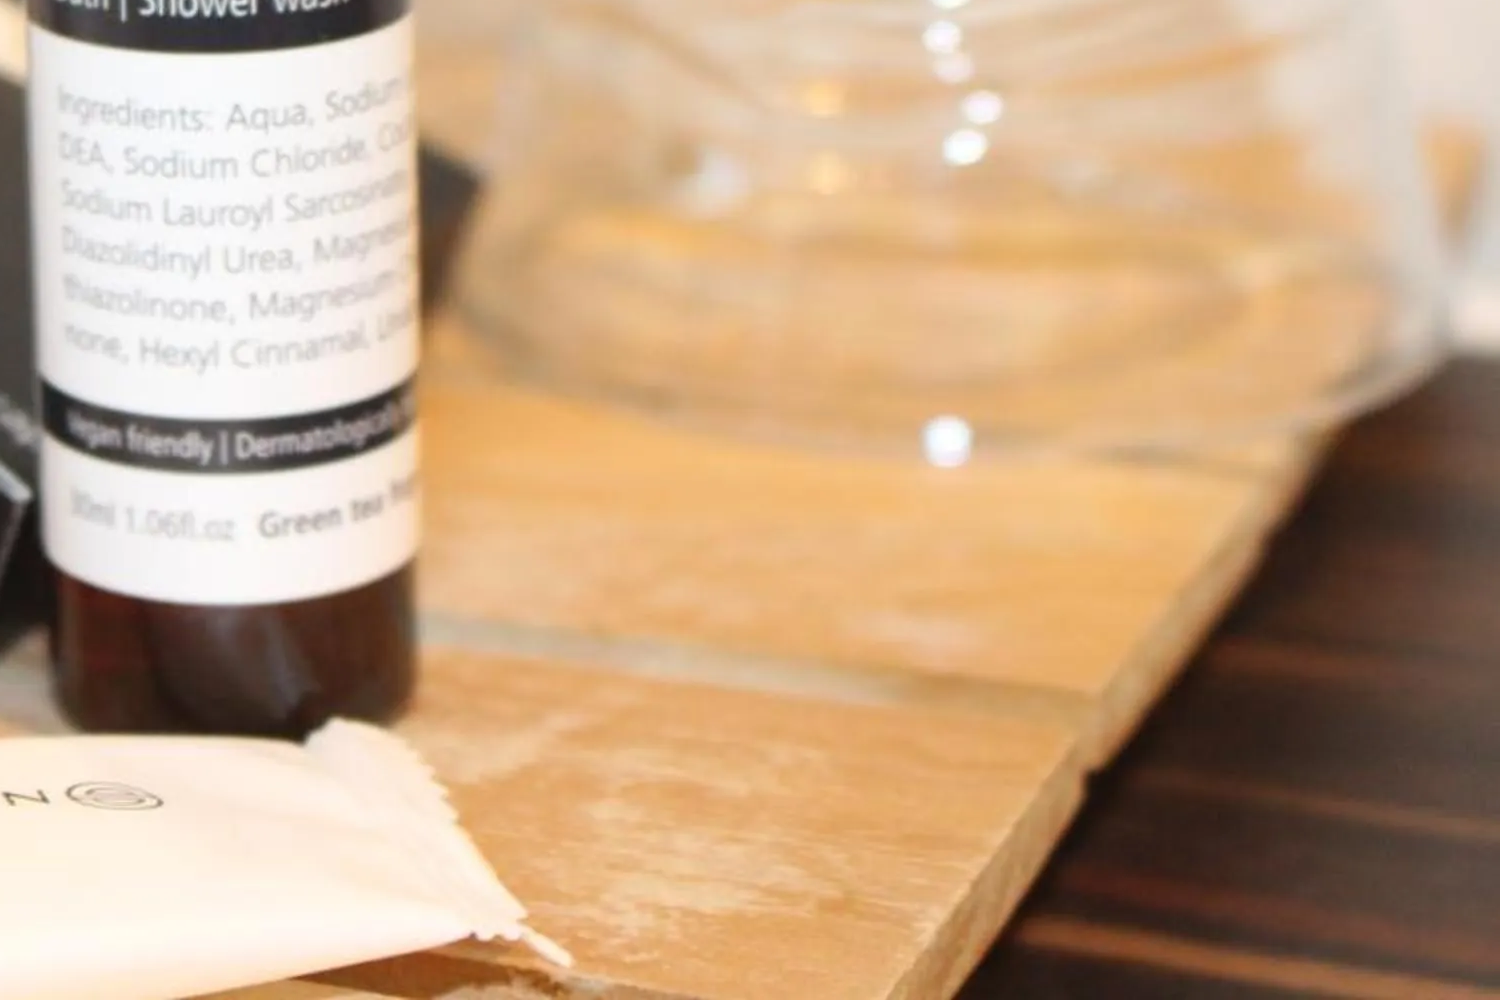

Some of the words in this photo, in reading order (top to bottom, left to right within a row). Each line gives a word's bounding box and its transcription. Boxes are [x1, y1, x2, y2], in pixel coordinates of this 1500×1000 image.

[225, 103, 315, 135] Aqua,
[124, 146, 238, 180] Sodium
[61, 178, 152, 222] Sodium
[163, 196, 274, 232] Lauroyl
[223, 246, 303, 277] Urea,
[139, 336, 220, 376] Hexyl
[126, 423, 214, 466] friendly
[258, 507, 343, 539] Green
